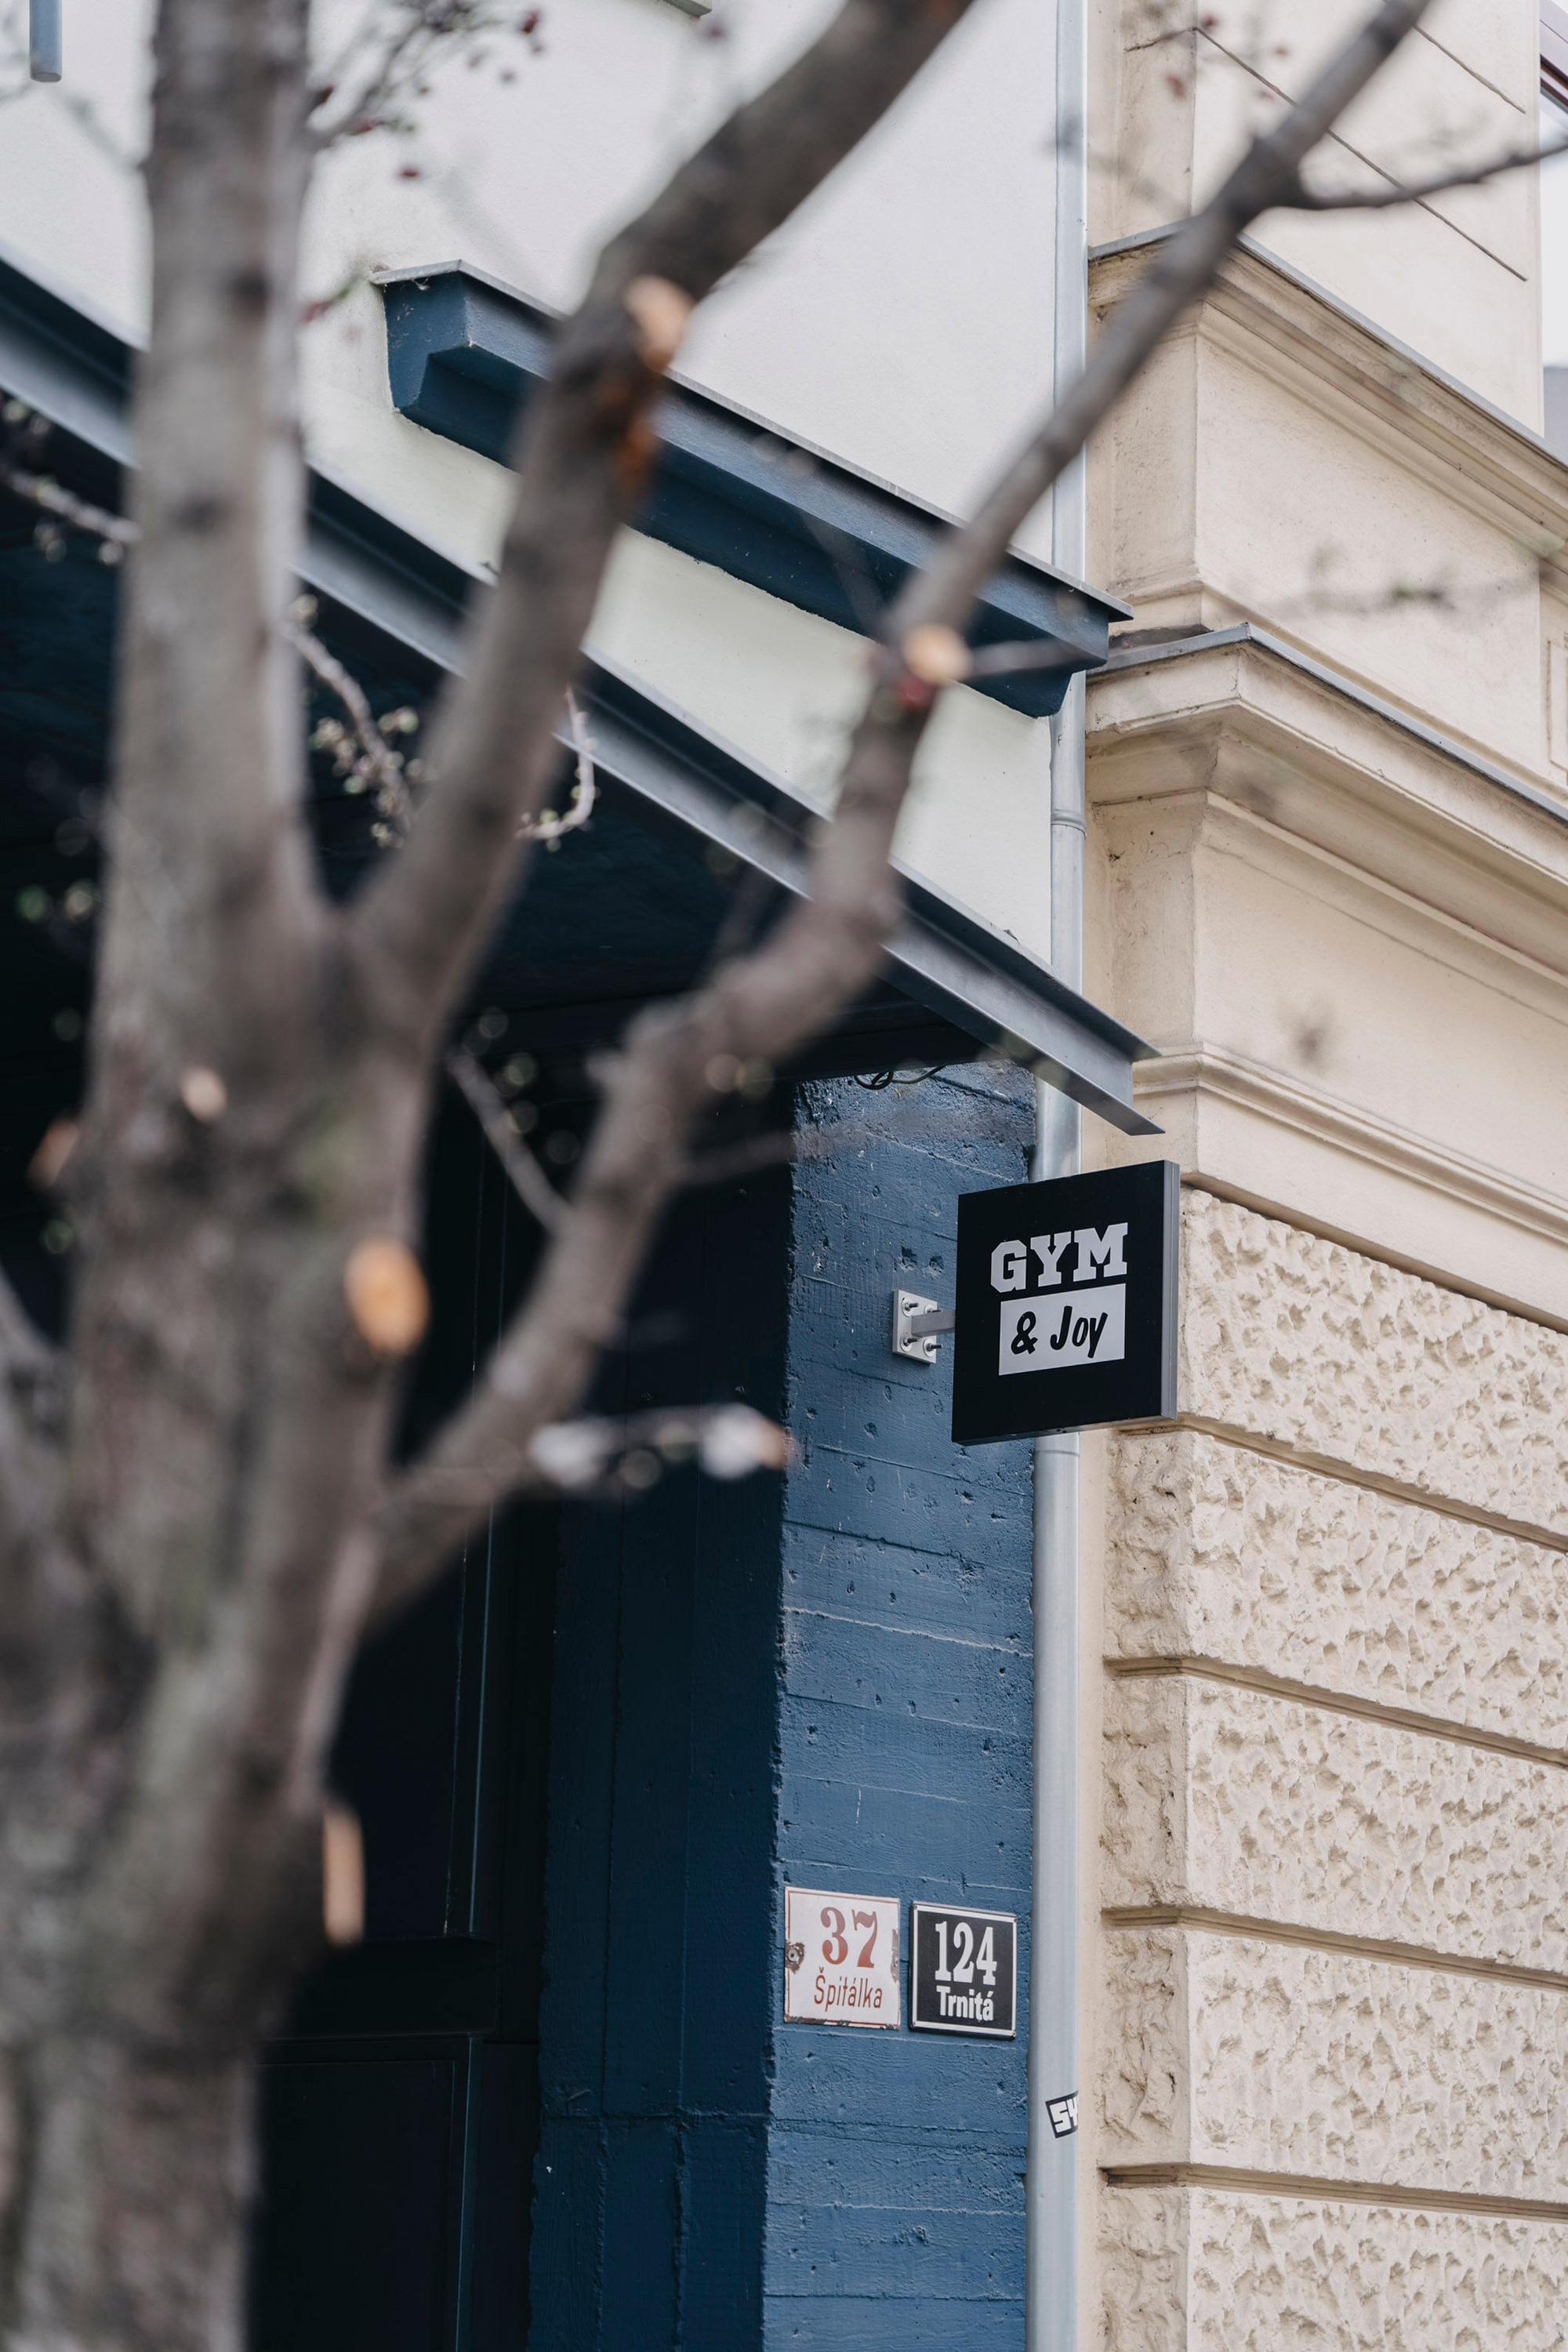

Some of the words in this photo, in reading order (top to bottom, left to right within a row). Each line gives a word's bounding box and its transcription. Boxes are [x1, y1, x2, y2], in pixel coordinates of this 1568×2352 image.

[990, 1221, 1128, 1293] GYM
[1011, 1311, 1038, 1355] &
[1050, 1305, 1108, 1359] Joy
[820, 1906, 878, 1969] 37
[935, 1921, 997, 1986] 124
[814, 1967, 883, 2013] Špitálka
[936, 1985, 994, 2022] Trnitá
